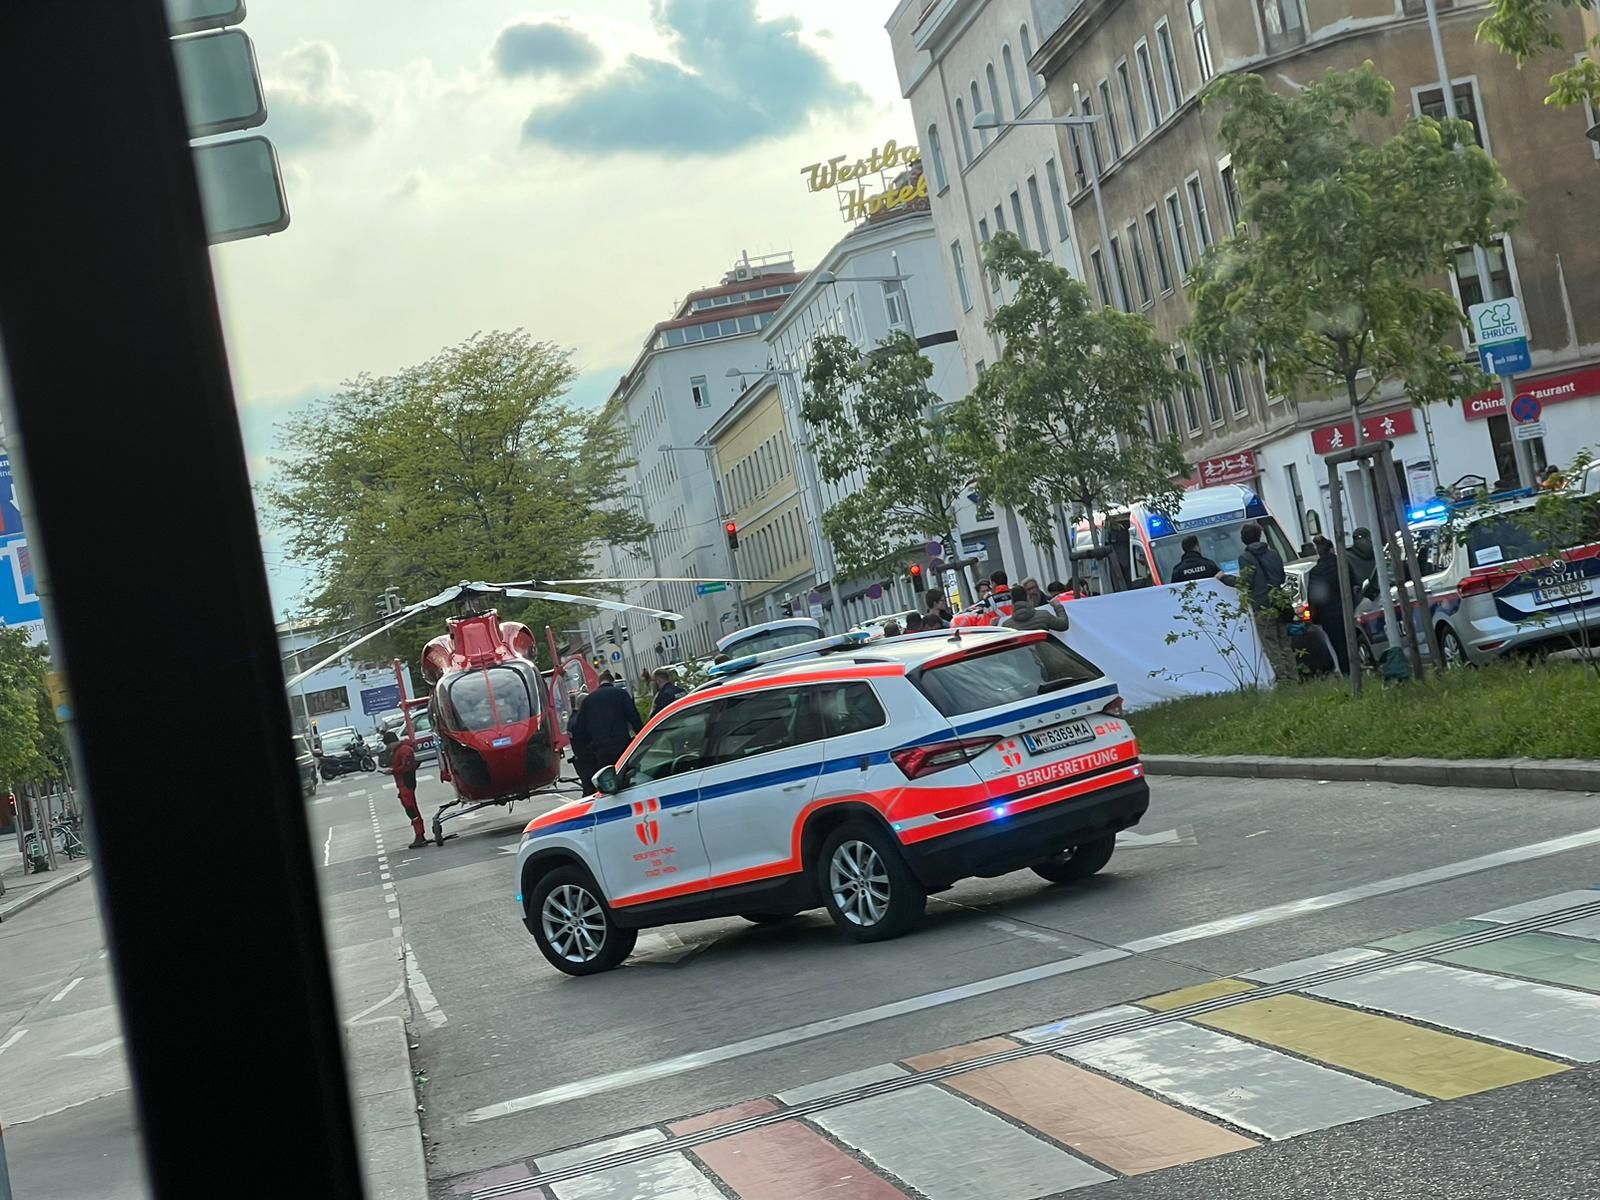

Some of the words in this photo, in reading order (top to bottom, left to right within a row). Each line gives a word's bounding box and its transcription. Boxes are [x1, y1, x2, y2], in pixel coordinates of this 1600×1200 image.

[800, 139, 921, 192] Westba
[840, 174, 928, 221] Hotel
[1482, 325, 1518, 340] EHRLICH
[1471, 398, 1506, 412] China
[1530, 382, 1576, 399] taurant
[1327, 416, 1396, 449] 老京
[1183, 565, 1206, 576] POLIZEI
[417, 740, 436, 750] POL
[1032, 733, 1042, 748] W
[1047, 726, 1075, 744] 6369
[1073, 720, 1091, 737] MA
[1017, 748, 1119, 788] BERUFSRETTUNG
